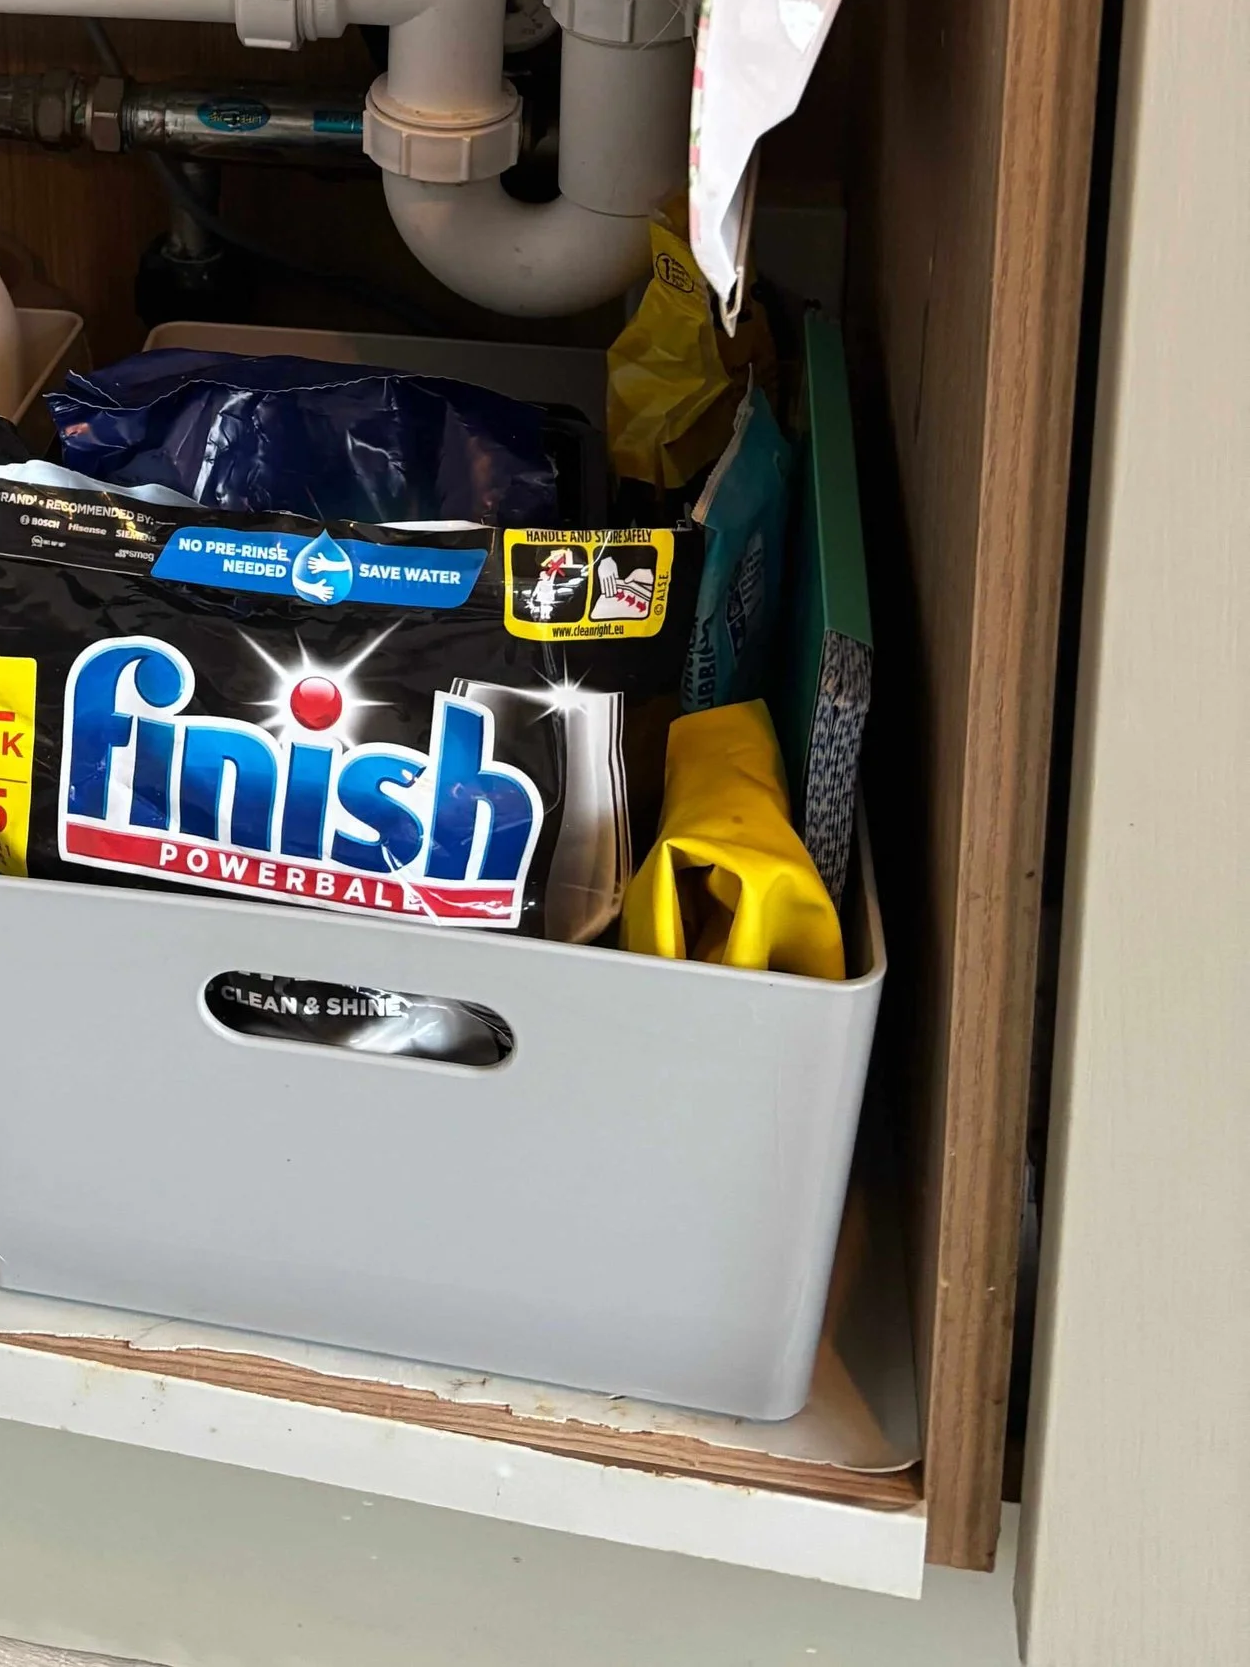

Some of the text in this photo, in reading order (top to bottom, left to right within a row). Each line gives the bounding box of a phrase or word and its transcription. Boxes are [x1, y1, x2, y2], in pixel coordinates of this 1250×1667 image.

[46, 499, 135, 521] RECOMMENDED
[136, 513, 155, 526] BY:
[31, 517, 157, 543] BOSCH Hisense SIEMENS
[526, 530, 567, 542] HANDLE
[570, 530, 592, 542] AND
[624, 529, 651, 543] SAFELY
[128, 550, 155, 563] smeg
[178, 537, 288, 561] NO PRE-RINSE
[223, 559, 287, 579] NEEDED
[359, 563, 461, 585] SAVE WATER
[66, 645, 534, 882] finish
[221, 984, 406, 1017] CLEAN & SHINE
